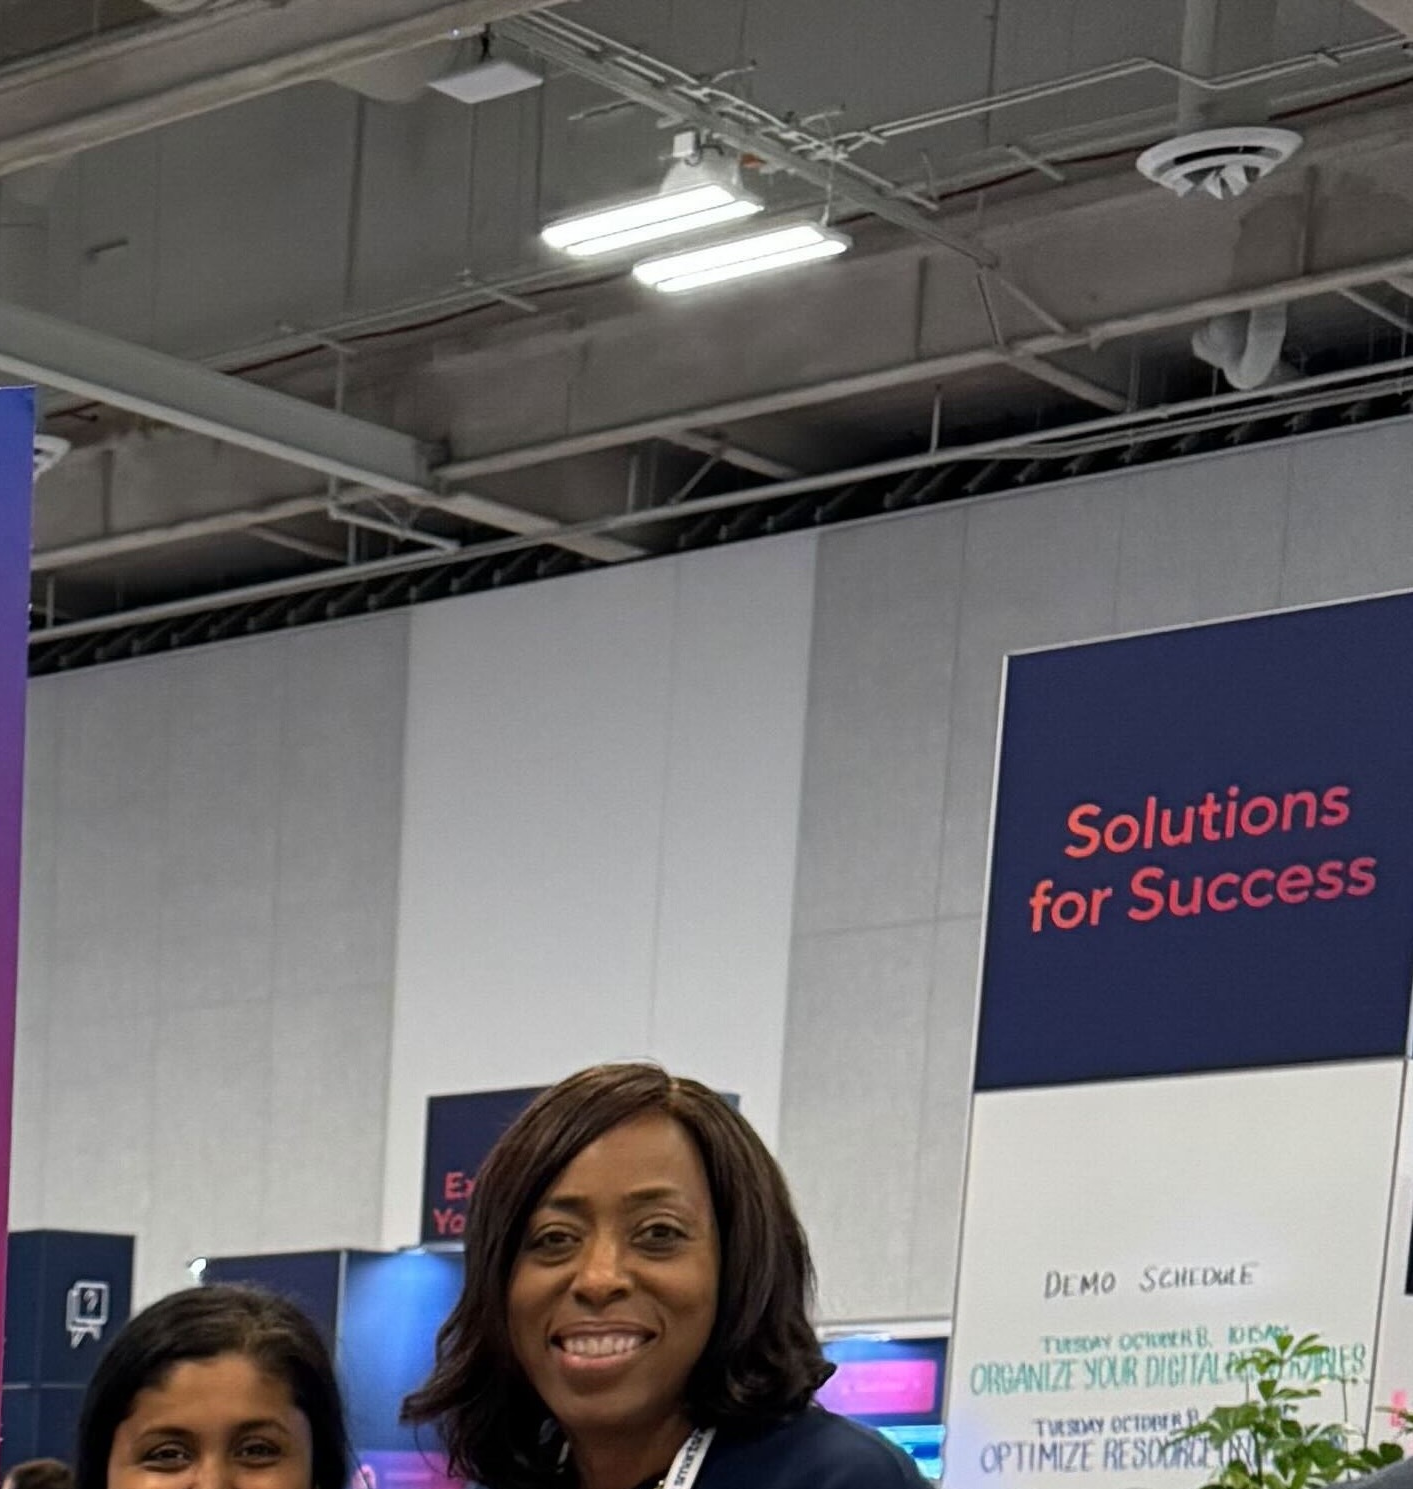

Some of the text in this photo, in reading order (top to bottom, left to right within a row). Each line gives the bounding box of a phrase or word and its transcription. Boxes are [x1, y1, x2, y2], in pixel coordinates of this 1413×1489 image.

[1064, 783, 1351, 859] Solutions
[1029, 854, 1377, 933] for Success
[1044, 1262, 1259, 1299] DEMO SCHEDULE
[969, 1358, 1078, 1396] ORGANIZE
[1083, 1355, 1138, 1390] YOUR
[980, 1439, 1095, 1474] OPTIMIZE
